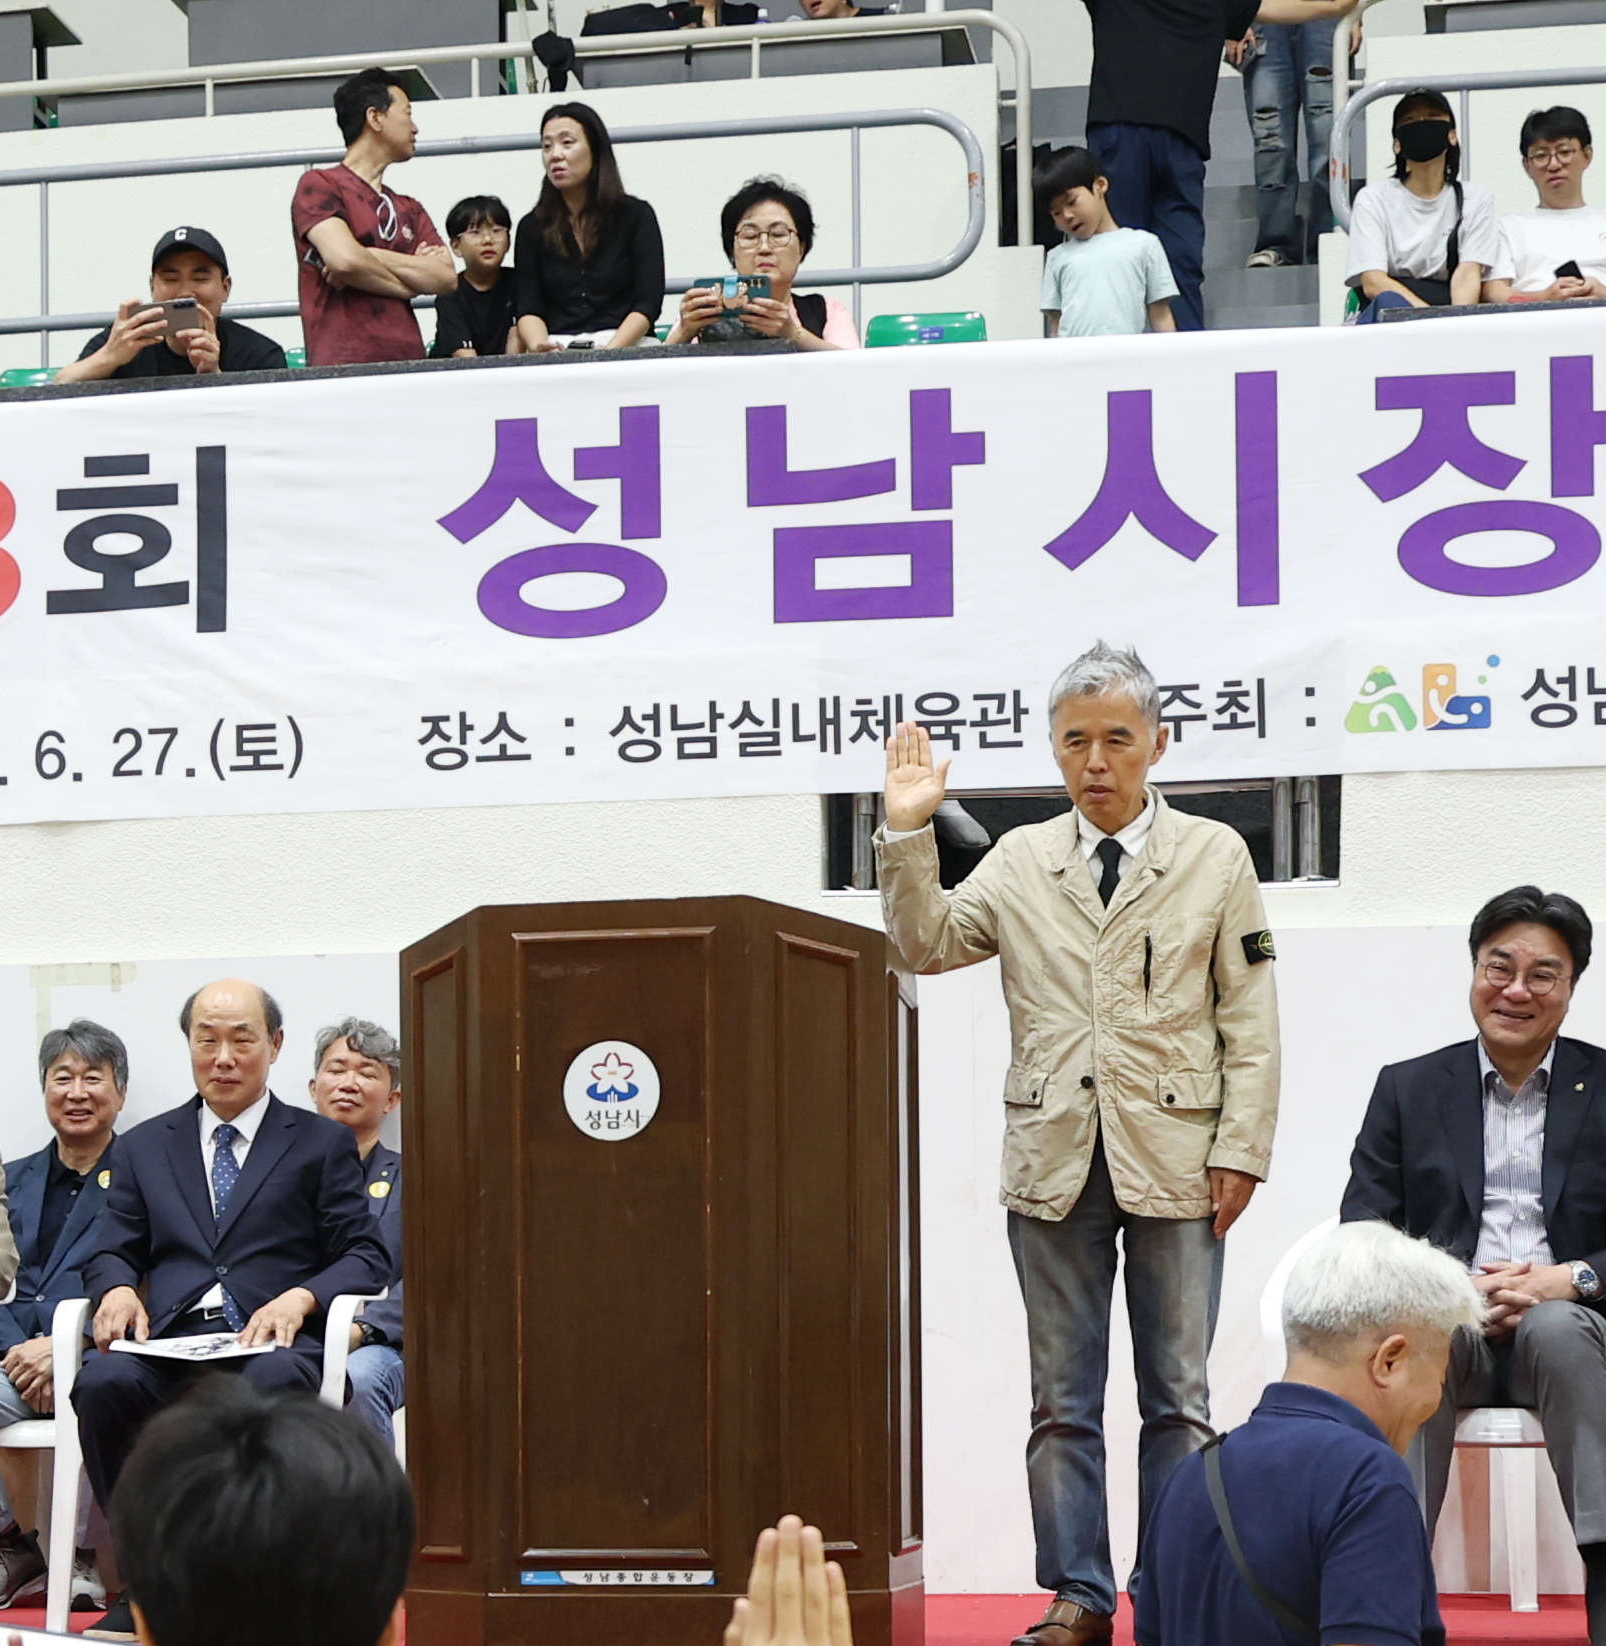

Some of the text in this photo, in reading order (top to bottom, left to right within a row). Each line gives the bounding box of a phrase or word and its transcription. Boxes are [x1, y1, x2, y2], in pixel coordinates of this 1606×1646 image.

[418, 712, 531, 770] 장소
[609, 689, 1029, 764] 성남실내체육관
[1158, 678, 1266, 743] 주최
[36, 731, 82, 781] 6.
[585, 1109, 640, 1131] 성남시
[582, 1572, 694, 1583] 성남종합운동장
